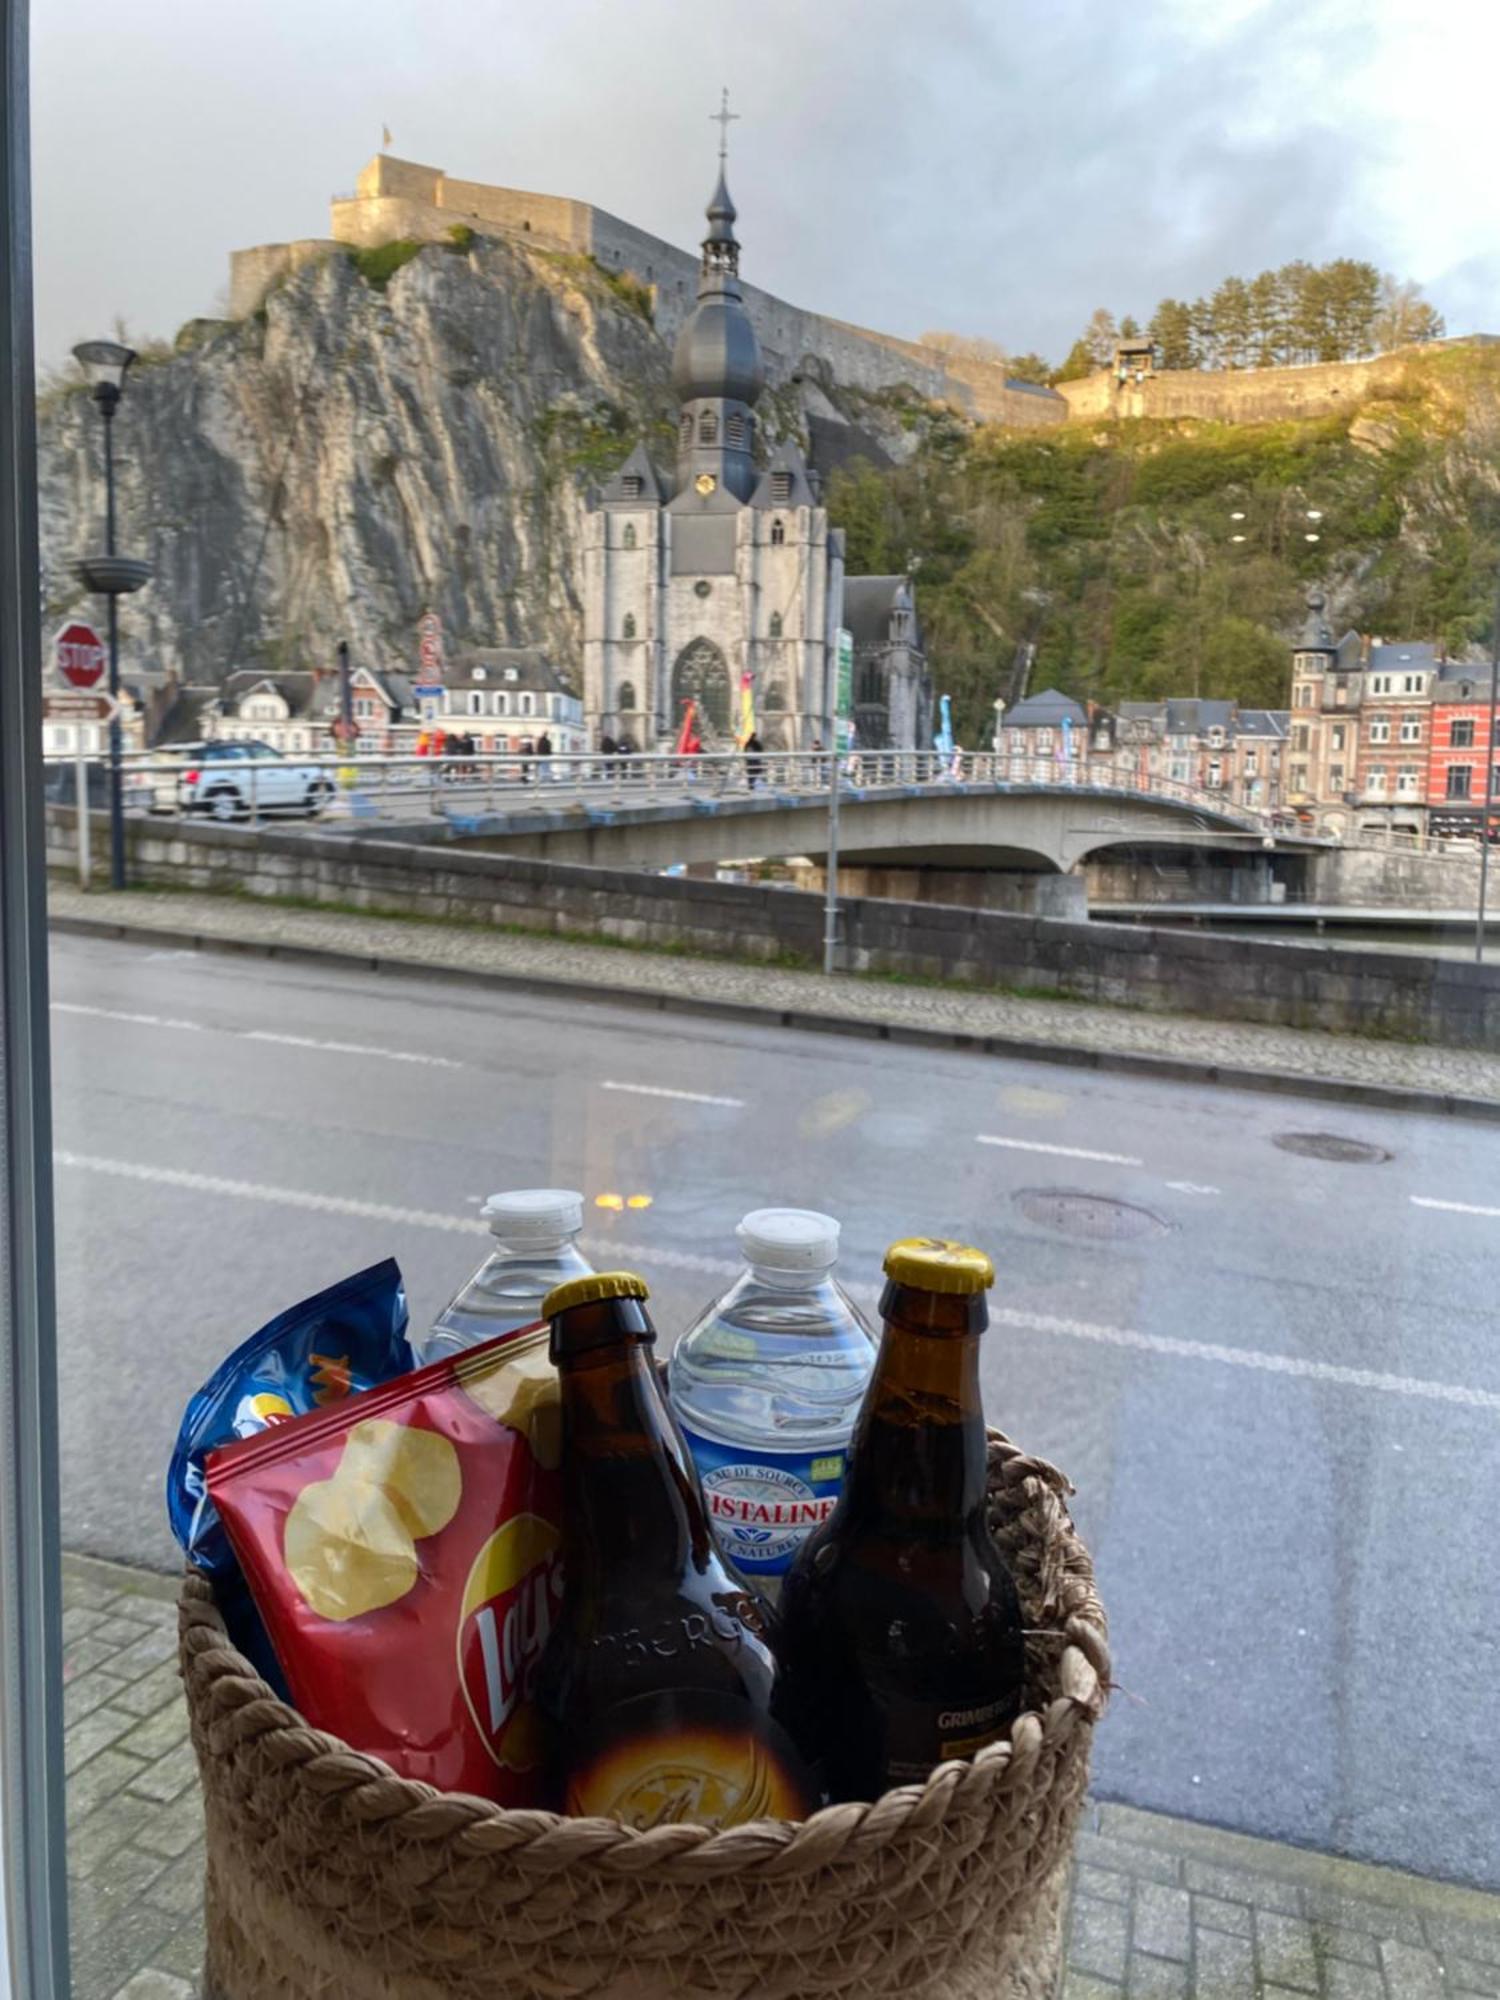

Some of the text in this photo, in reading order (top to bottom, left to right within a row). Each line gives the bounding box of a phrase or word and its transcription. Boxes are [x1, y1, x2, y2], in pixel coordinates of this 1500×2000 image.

[58, 642, 108, 670] STOP
[707, 1468, 730, 1486] EAU
[735, 1467, 753, 1478] DE
[704, 1489, 834, 1523] ISTALINE
